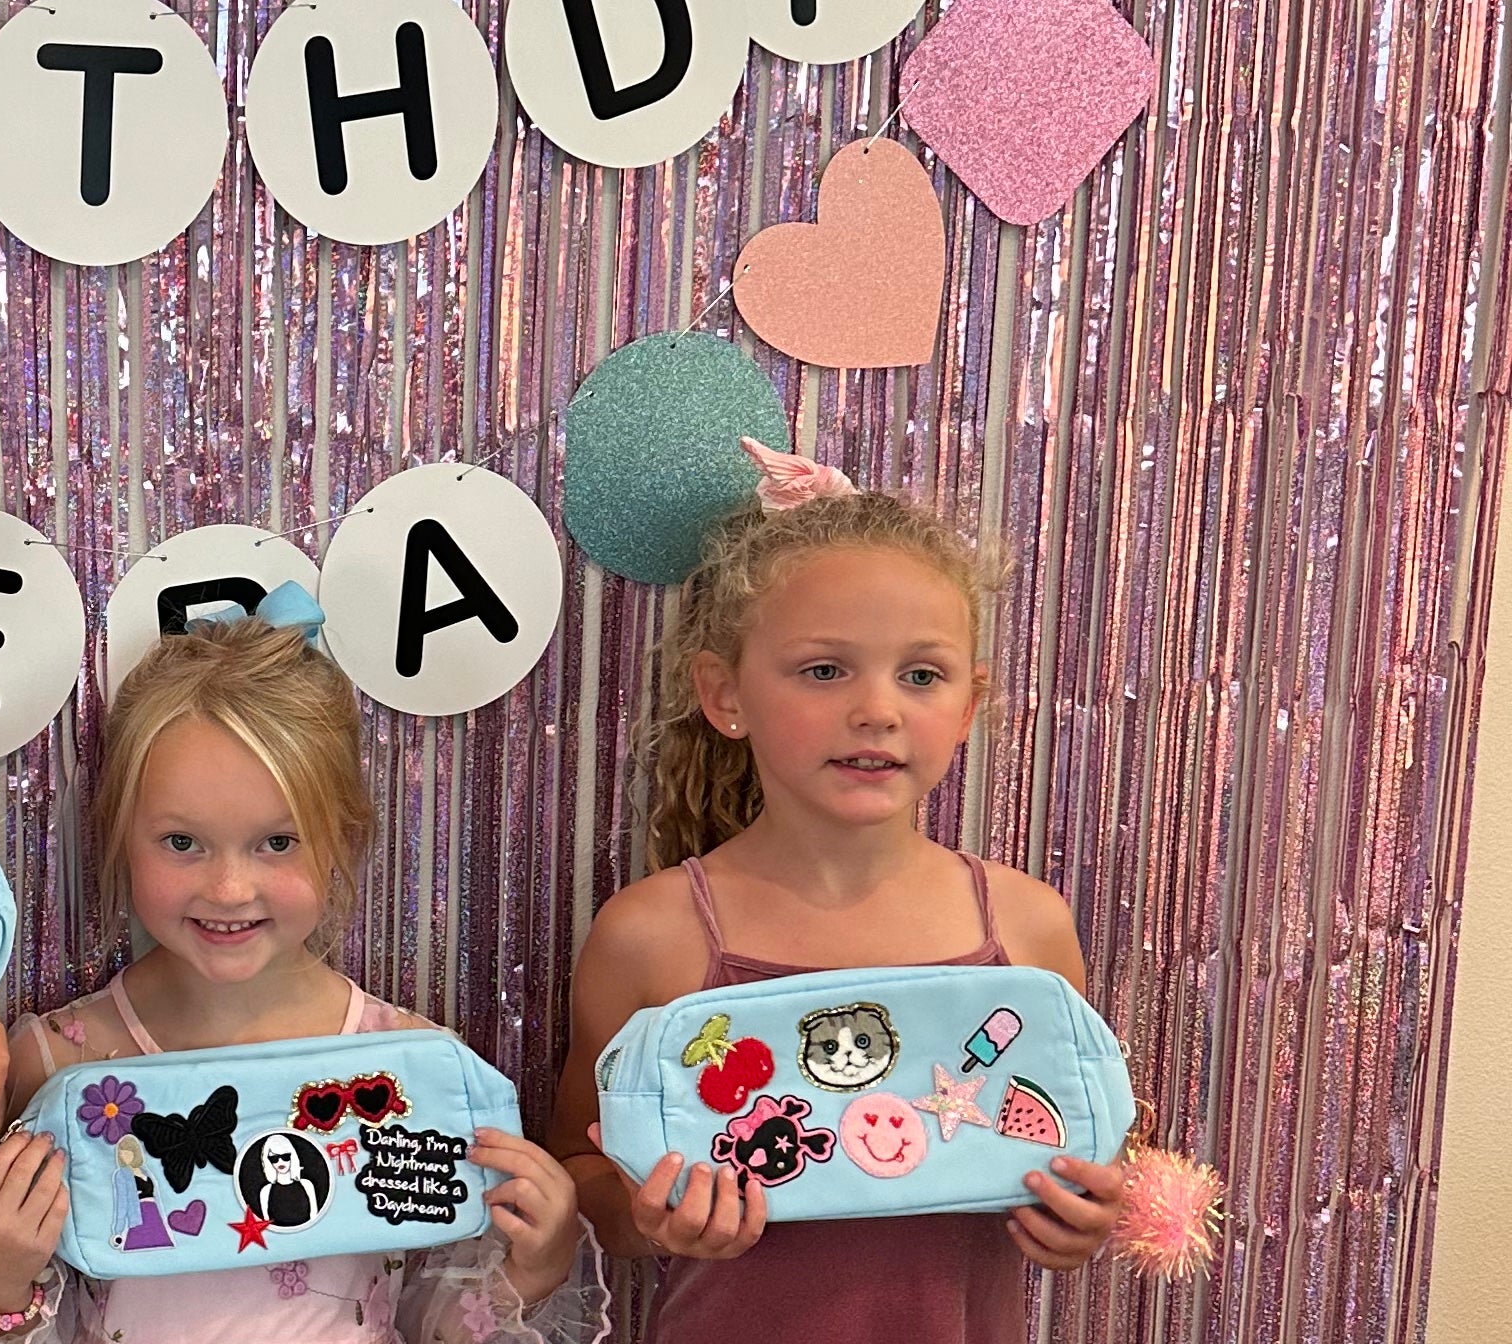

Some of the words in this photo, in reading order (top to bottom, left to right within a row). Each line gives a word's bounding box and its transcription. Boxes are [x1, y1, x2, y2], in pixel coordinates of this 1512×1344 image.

[365, 1128, 422, 1156] Darling,
[452, 1143, 462, 1155] a
[374, 1150, 450, 1175] Nightmare
[361, 1169, 420, 1194] dressed
[422, 1176, 449, 1195] like
[452, 1185, 463, 1197] a
[371, 1192, 450, 1219] Daydream
